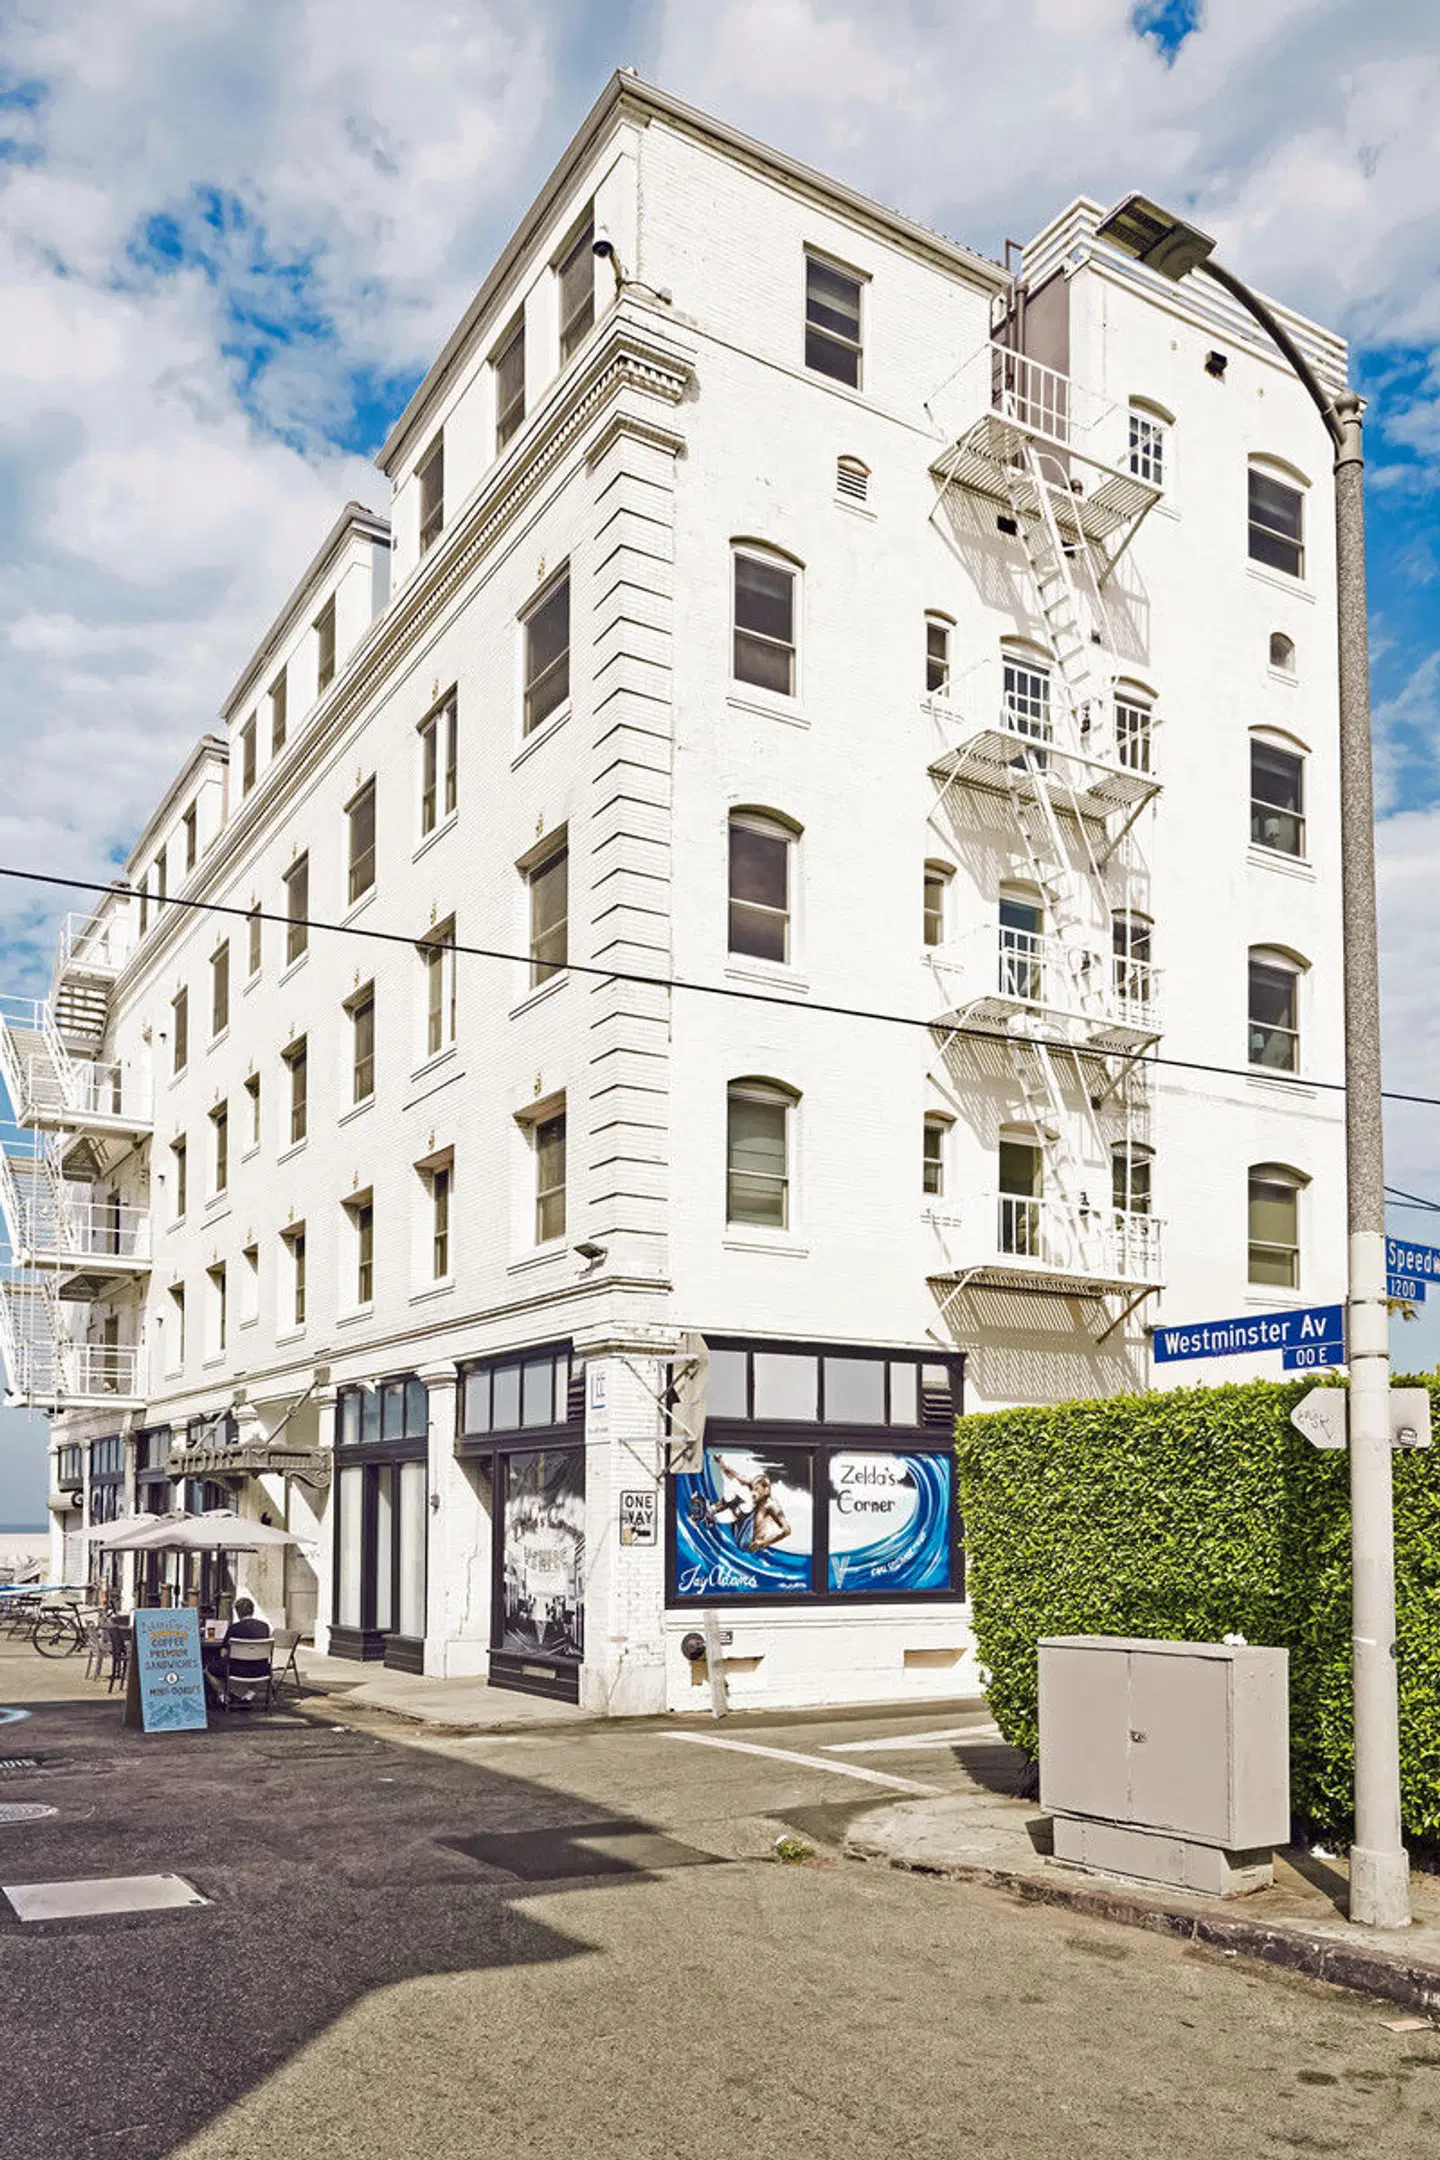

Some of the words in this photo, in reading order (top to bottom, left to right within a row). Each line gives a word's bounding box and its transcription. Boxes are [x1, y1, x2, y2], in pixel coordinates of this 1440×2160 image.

[1391, 1278, 1416, 1298] 1200
[1165, 1321, 1291, 1355] Westminster
[1300, 1314, 1327, 1339] Av
[1296, 1349, 1315, 1366] 00
[1319, 1347, 1328, 1364] E
[840, 1464, 896, 1486] Zelda's
[625, 1495, 653, 1508] ONE
[837, 1489, 896, 1514] Corner
[679, 1564, 709, 1595] Jay
[709, 1564, 759, 1588] Adams
